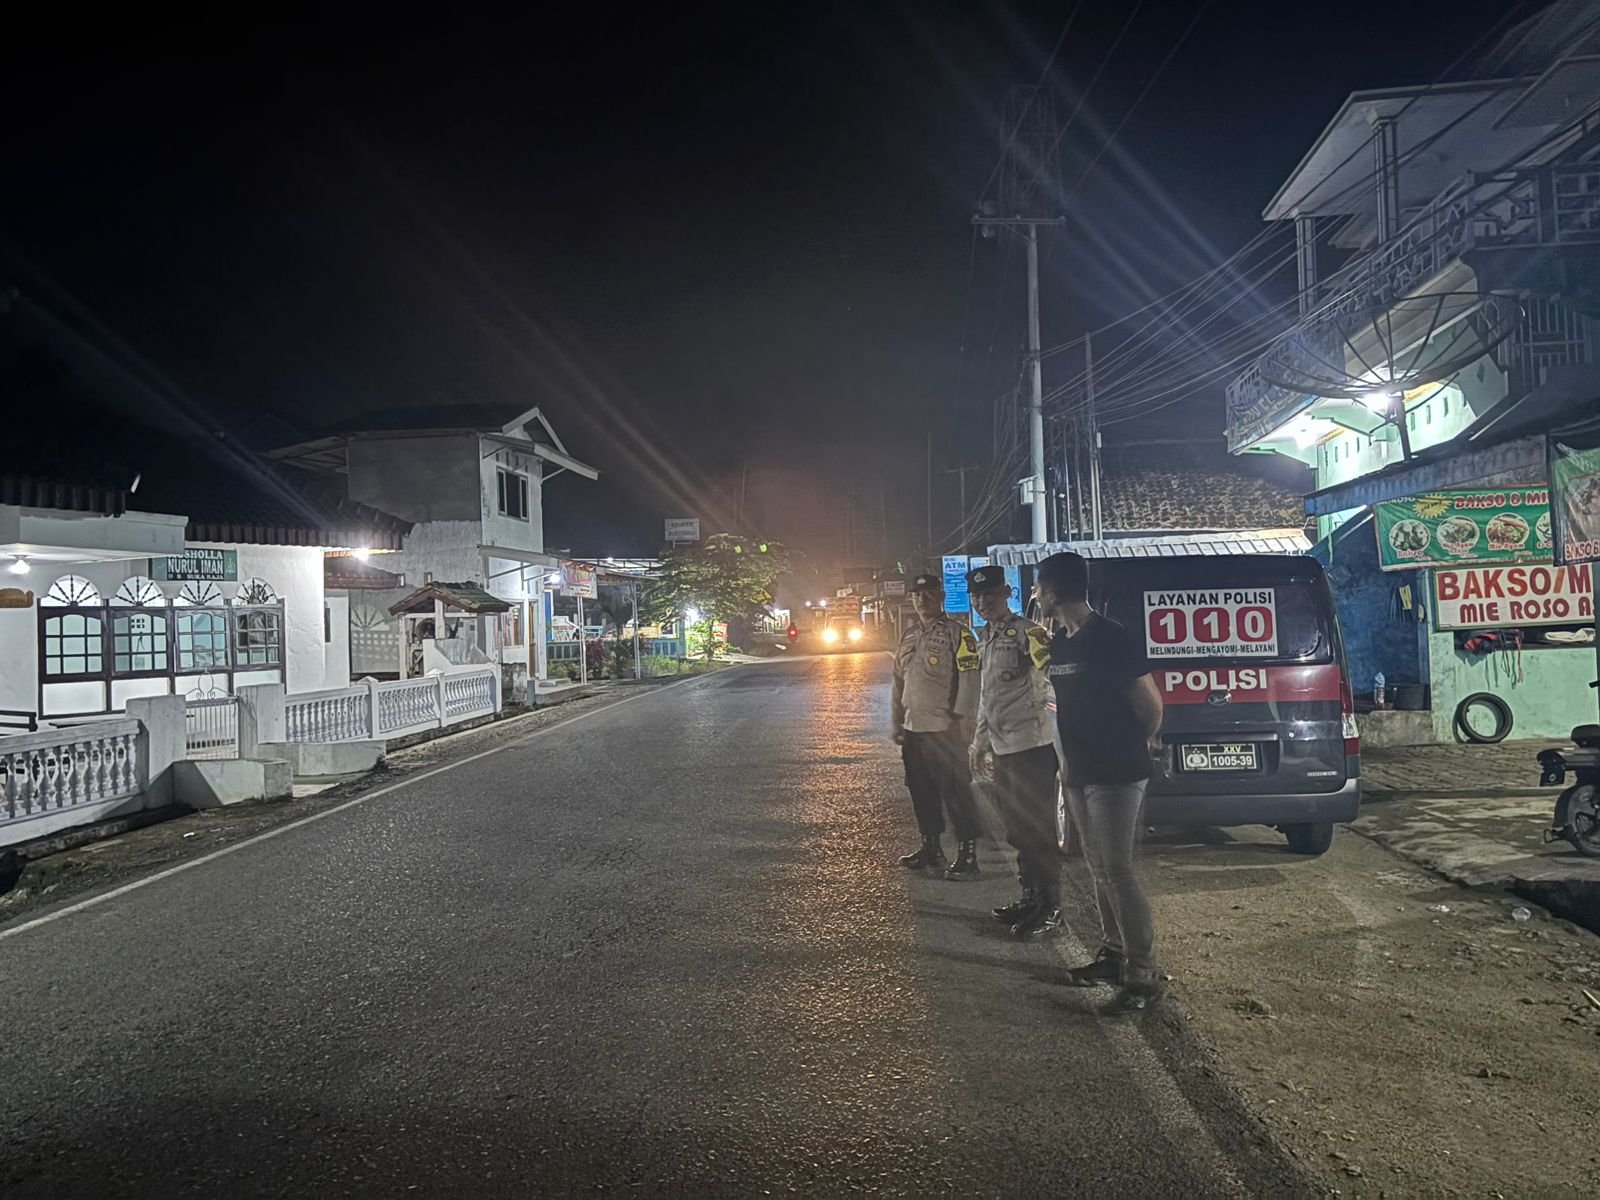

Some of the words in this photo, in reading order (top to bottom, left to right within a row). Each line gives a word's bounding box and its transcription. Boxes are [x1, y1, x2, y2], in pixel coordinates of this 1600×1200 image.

[1454, 494, 1506, 509] BAKSO
[168, 558, 198, 573] NURUL
[201, 559, 223, 574] IMAN
[1148, 593, 1219, 606] LAYANAN
[1224, 592, 1272, 604] POLISI
[1460, 601, 1500, 624] MIE
[1510, 597, 1570, 620] ROSO
[1578, 596, 1595, 616] A
[1165, 669, 1267, 691] POLISI
[1213, 756, 1253, 767] 1005-39
